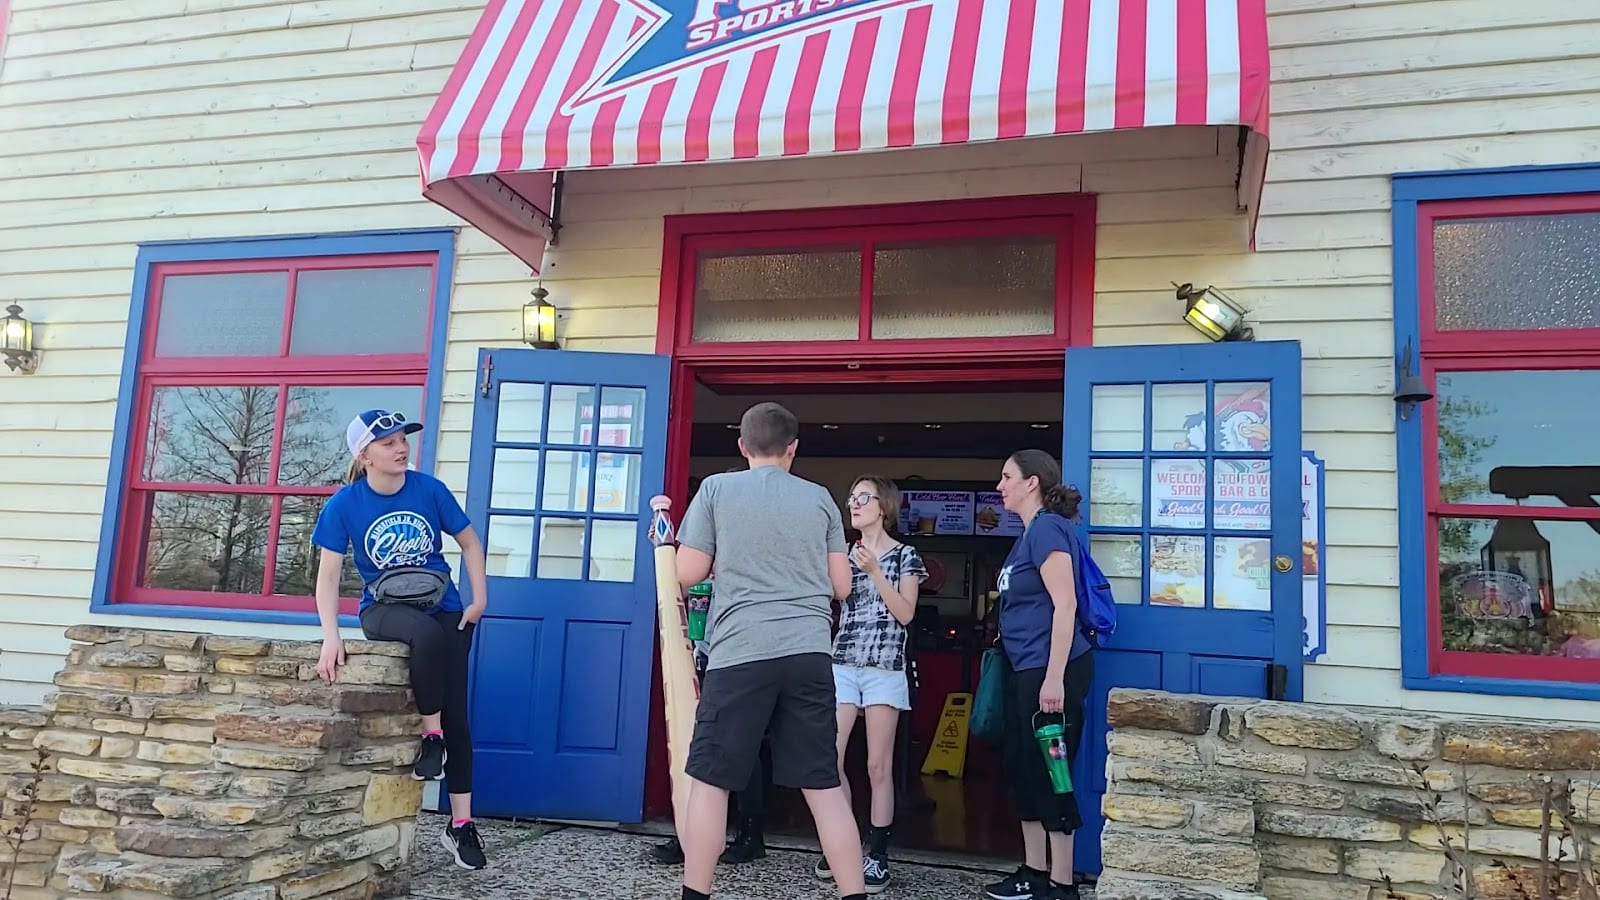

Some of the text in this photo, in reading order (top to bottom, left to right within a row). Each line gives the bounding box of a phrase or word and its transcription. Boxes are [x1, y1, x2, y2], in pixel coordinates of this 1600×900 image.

[1221, 473, 1236, 484] TO
[1240, 473, 1269, 485] FOW
[1220, 486, 1243, 497] BAR
[1248, 486, 1257, 497] &
[1167, 501, 1198, 517] Good
[1229, 502, 1260, 518] Good
